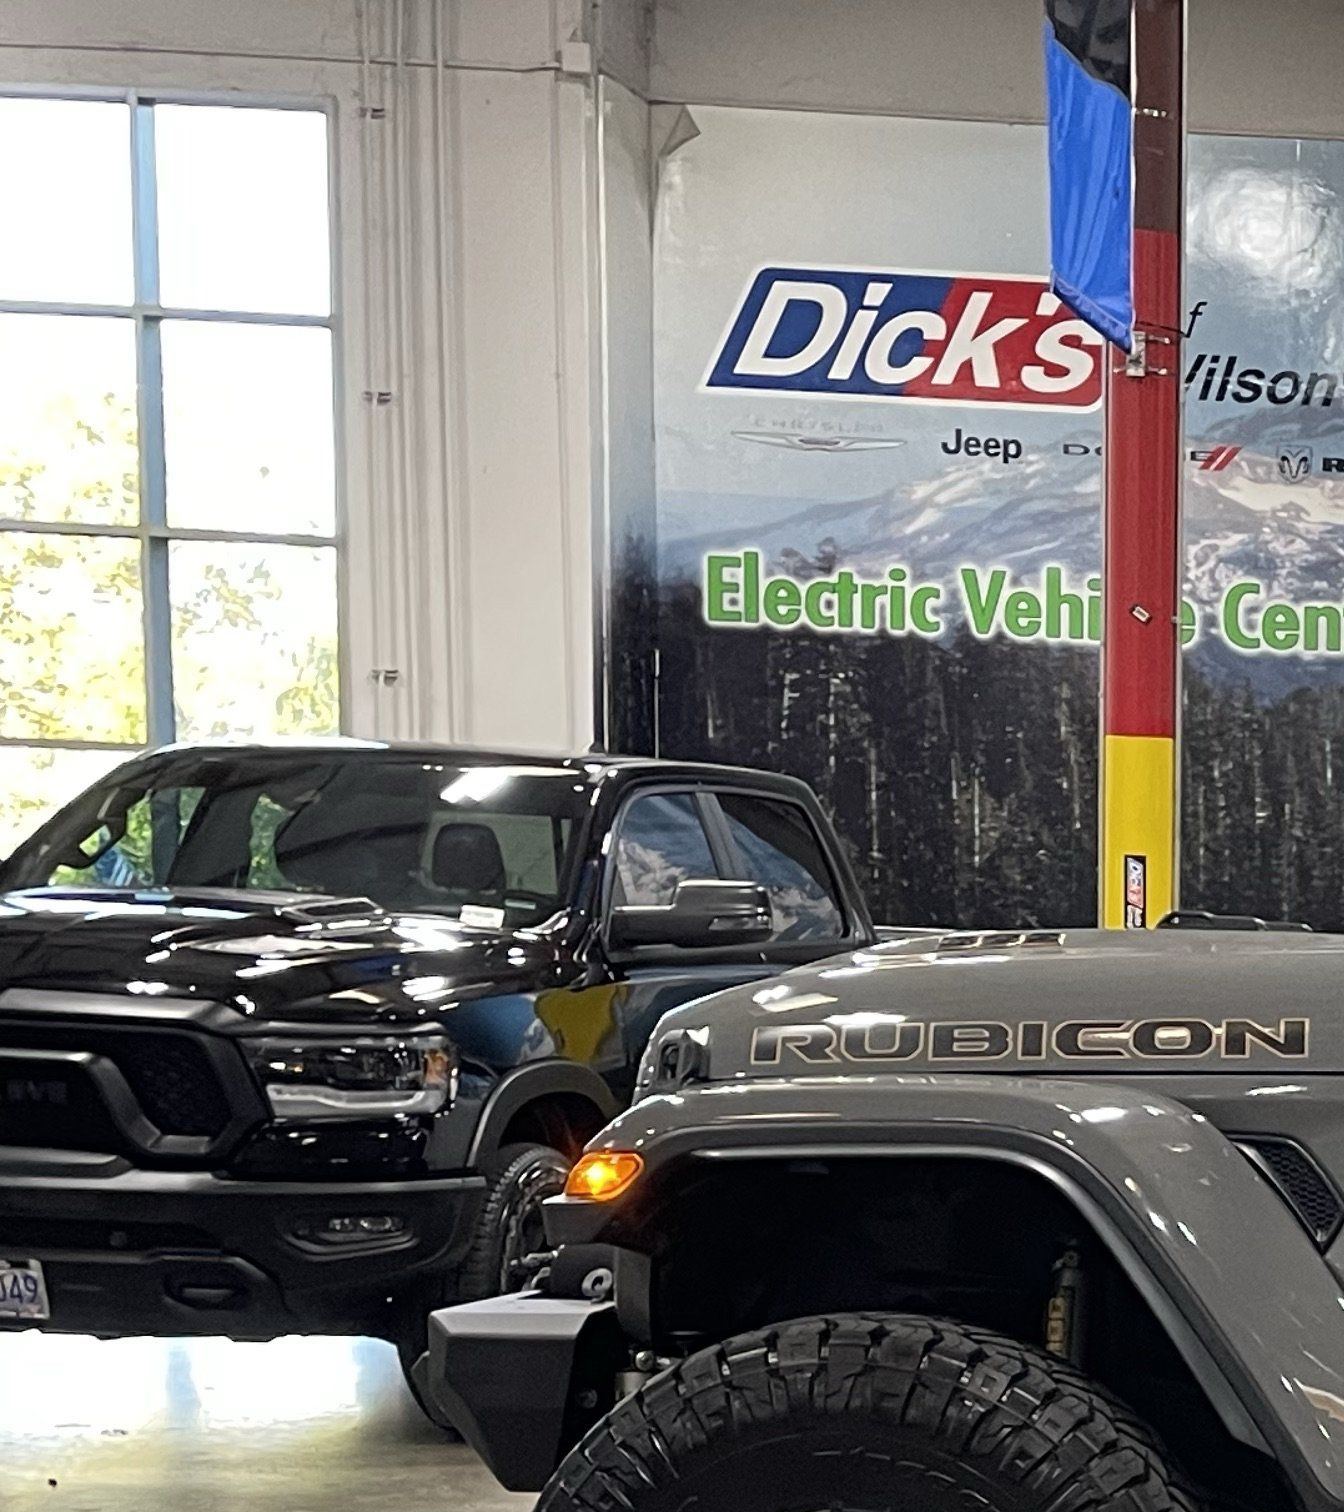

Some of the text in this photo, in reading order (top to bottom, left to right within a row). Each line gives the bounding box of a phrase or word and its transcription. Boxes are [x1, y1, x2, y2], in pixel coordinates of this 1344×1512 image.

[733, 280, 1105, 394] Dick's
[941, 428, 1022, 464] Jeep
[707, 551, 941, 634] Electric
[961, 566, 1197, 647] Vehi
[750, 1017, 1311, 1066] RUBICON
